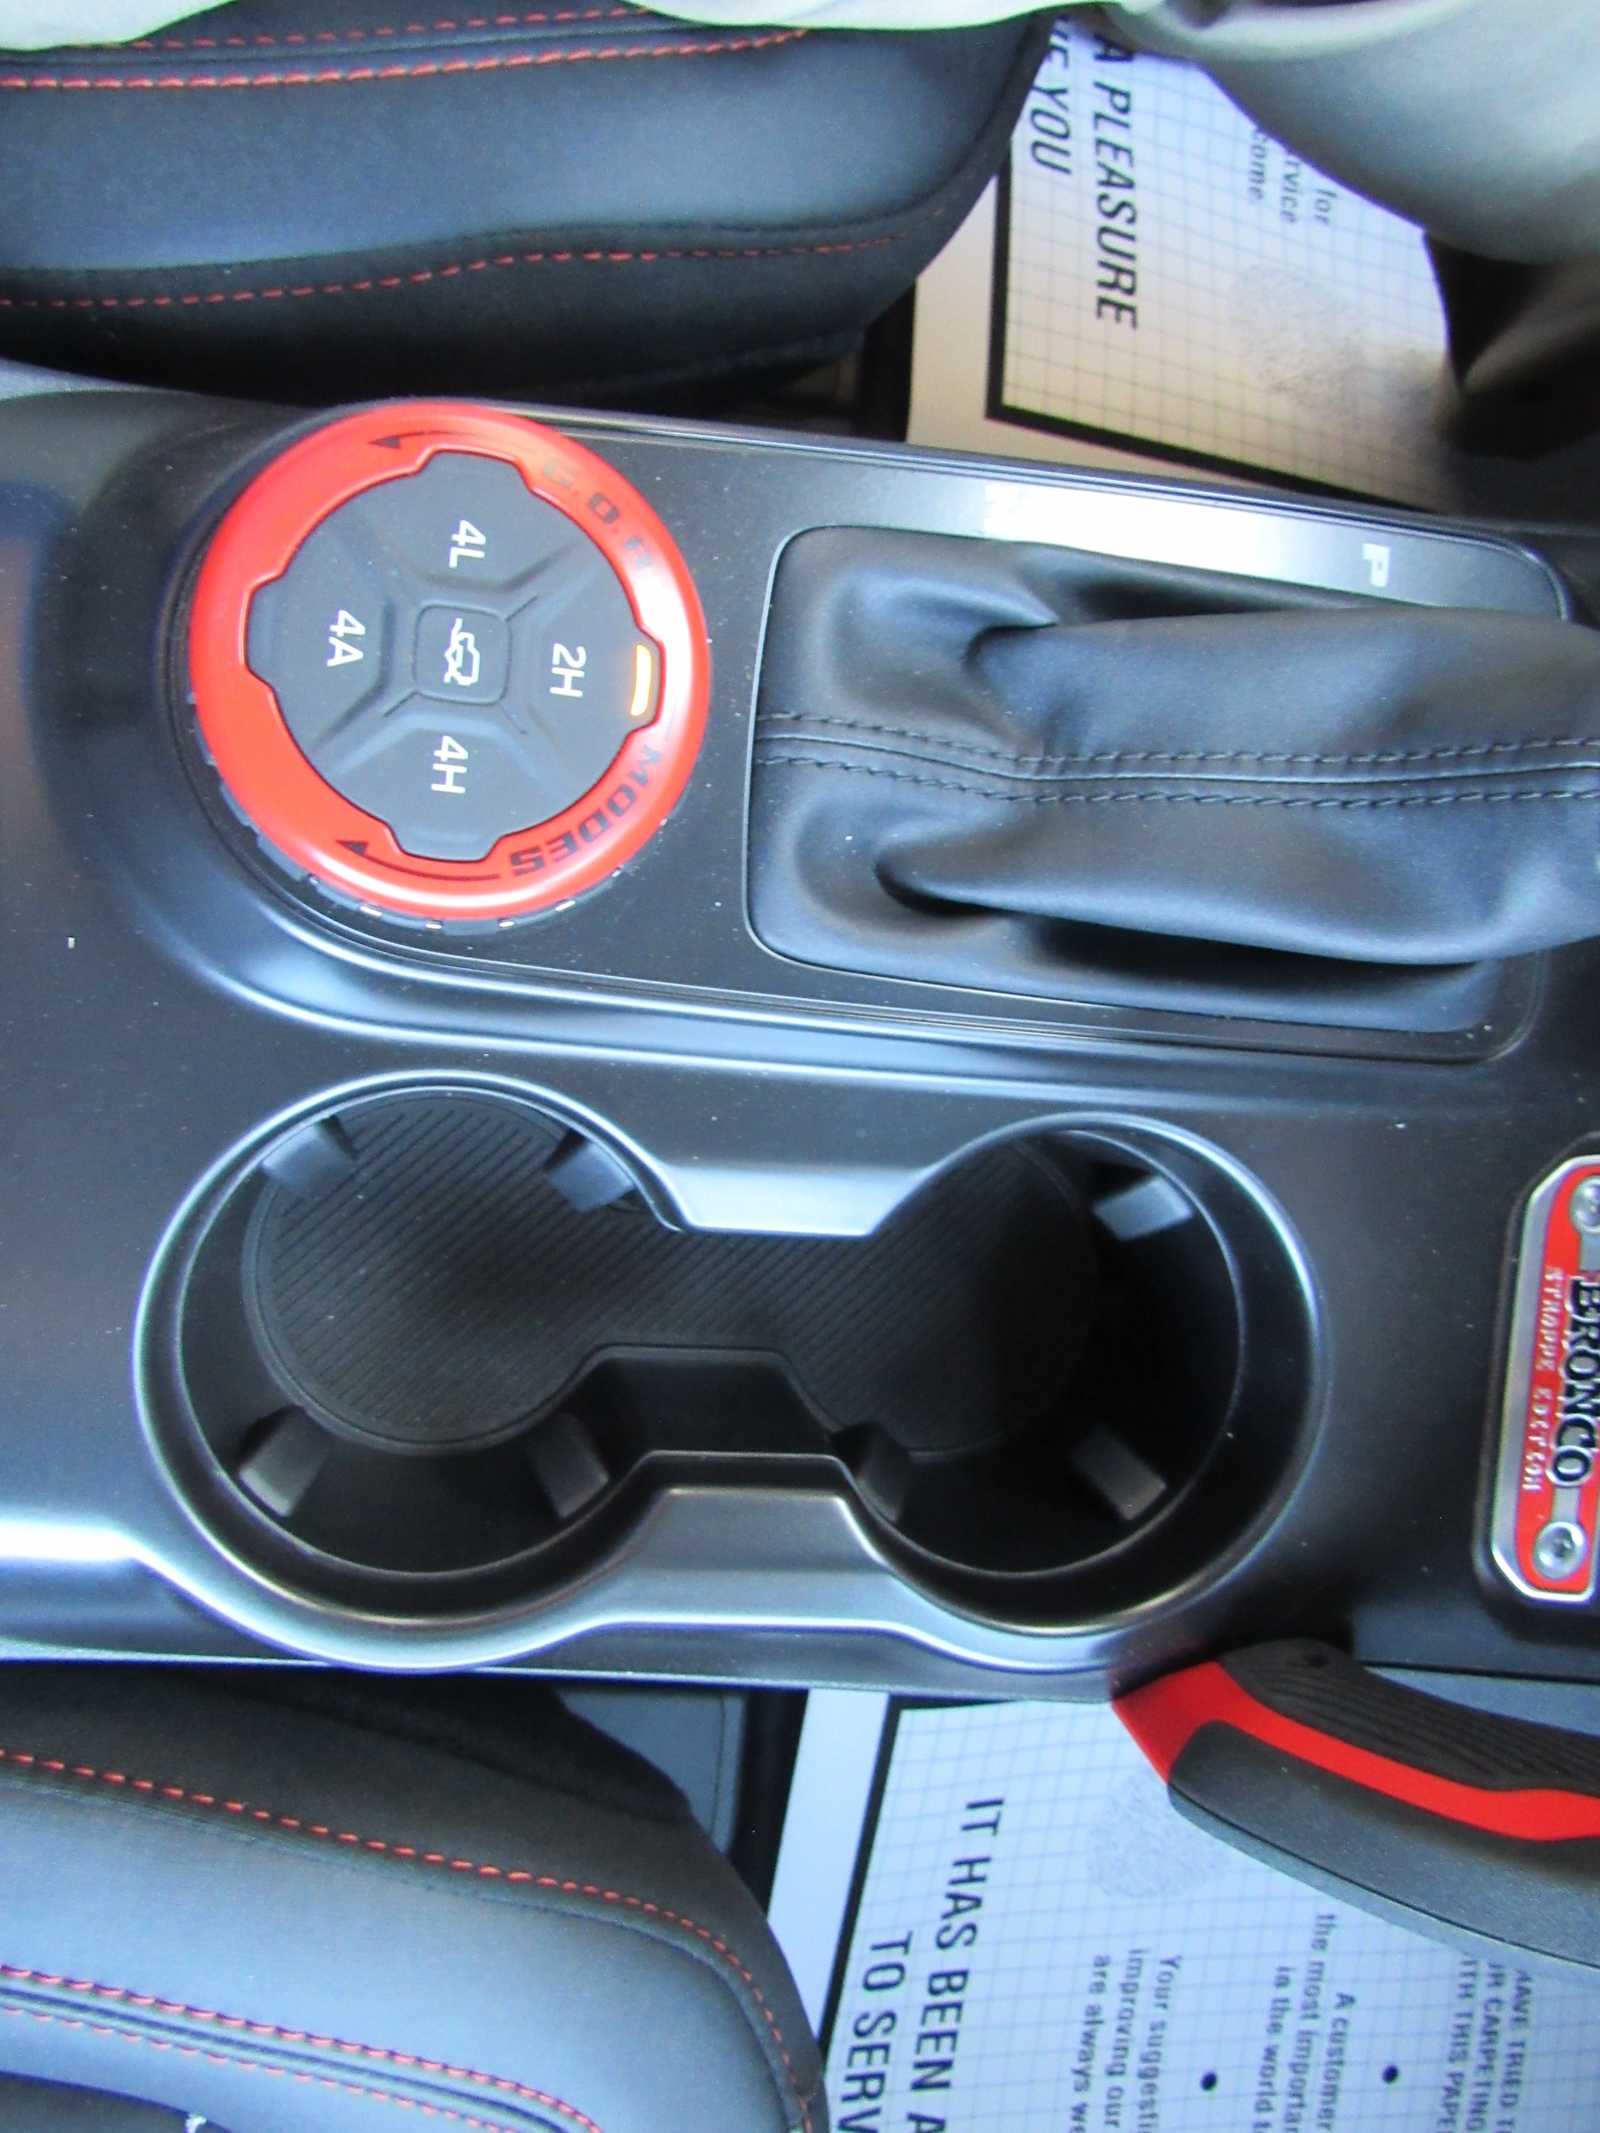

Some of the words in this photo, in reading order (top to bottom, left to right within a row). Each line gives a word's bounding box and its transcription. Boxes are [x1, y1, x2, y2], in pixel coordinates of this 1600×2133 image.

[1094, 34, 1134, 63] A
[1029, 82, 1073, 175] YOU
[1092, 82, 1138, 330] PLEASURE
[1279, 152, 1304, 225] rvice
[1314, 189, 1337, 226] for
[448, 519, 486, 568] 4L
[1362, 543, 1390, 587] P
[327, 609, 366, 668] 4A
[549, 642, 588, 698] 2H
[431, 735, 469, 794] 4H
[509, 744, 664, 877] MODES
[1549, 1275, 1600, 1486] BRONCO
[960, 1797, 1005, 1837] IT
[934, 1856, 993, 1951] HAS
[1312, 1914, 1337, 1952] the
[861, 1930, 913, 1993] TO
[1089, 1955, 1111, 1995] are
[1154, 1955, 1183, 2010] Your
[1300, 1961, 1326, 2020] most
[1458, 1959, 1478, 1999] ITH
[909, 1969, 970, 2092] BEEN
[1106, 1948, 1150, 2077] improving
[1267, 1997, 1291, 2035] the
[1335, 1993, 1355, 2009] A
[1071, 2004, 1105, 2093] always
[1449, 2011, 1473, 2063] THIS
[1466, 1998, 1505, 2131] CARPETING
[838, 2009, 897, 2133] SERV
[1138, 2020, 1167, 2133] suggesti
[1255, 2045, 1281, 2113] world
[1316, 2017, 1350, 2131] customer
[1499, 2041, 1526, 2108] TRIED
[1104, 2086, 1125, 2128] our
[1437, 2072, 1466, 2133] PAPE
